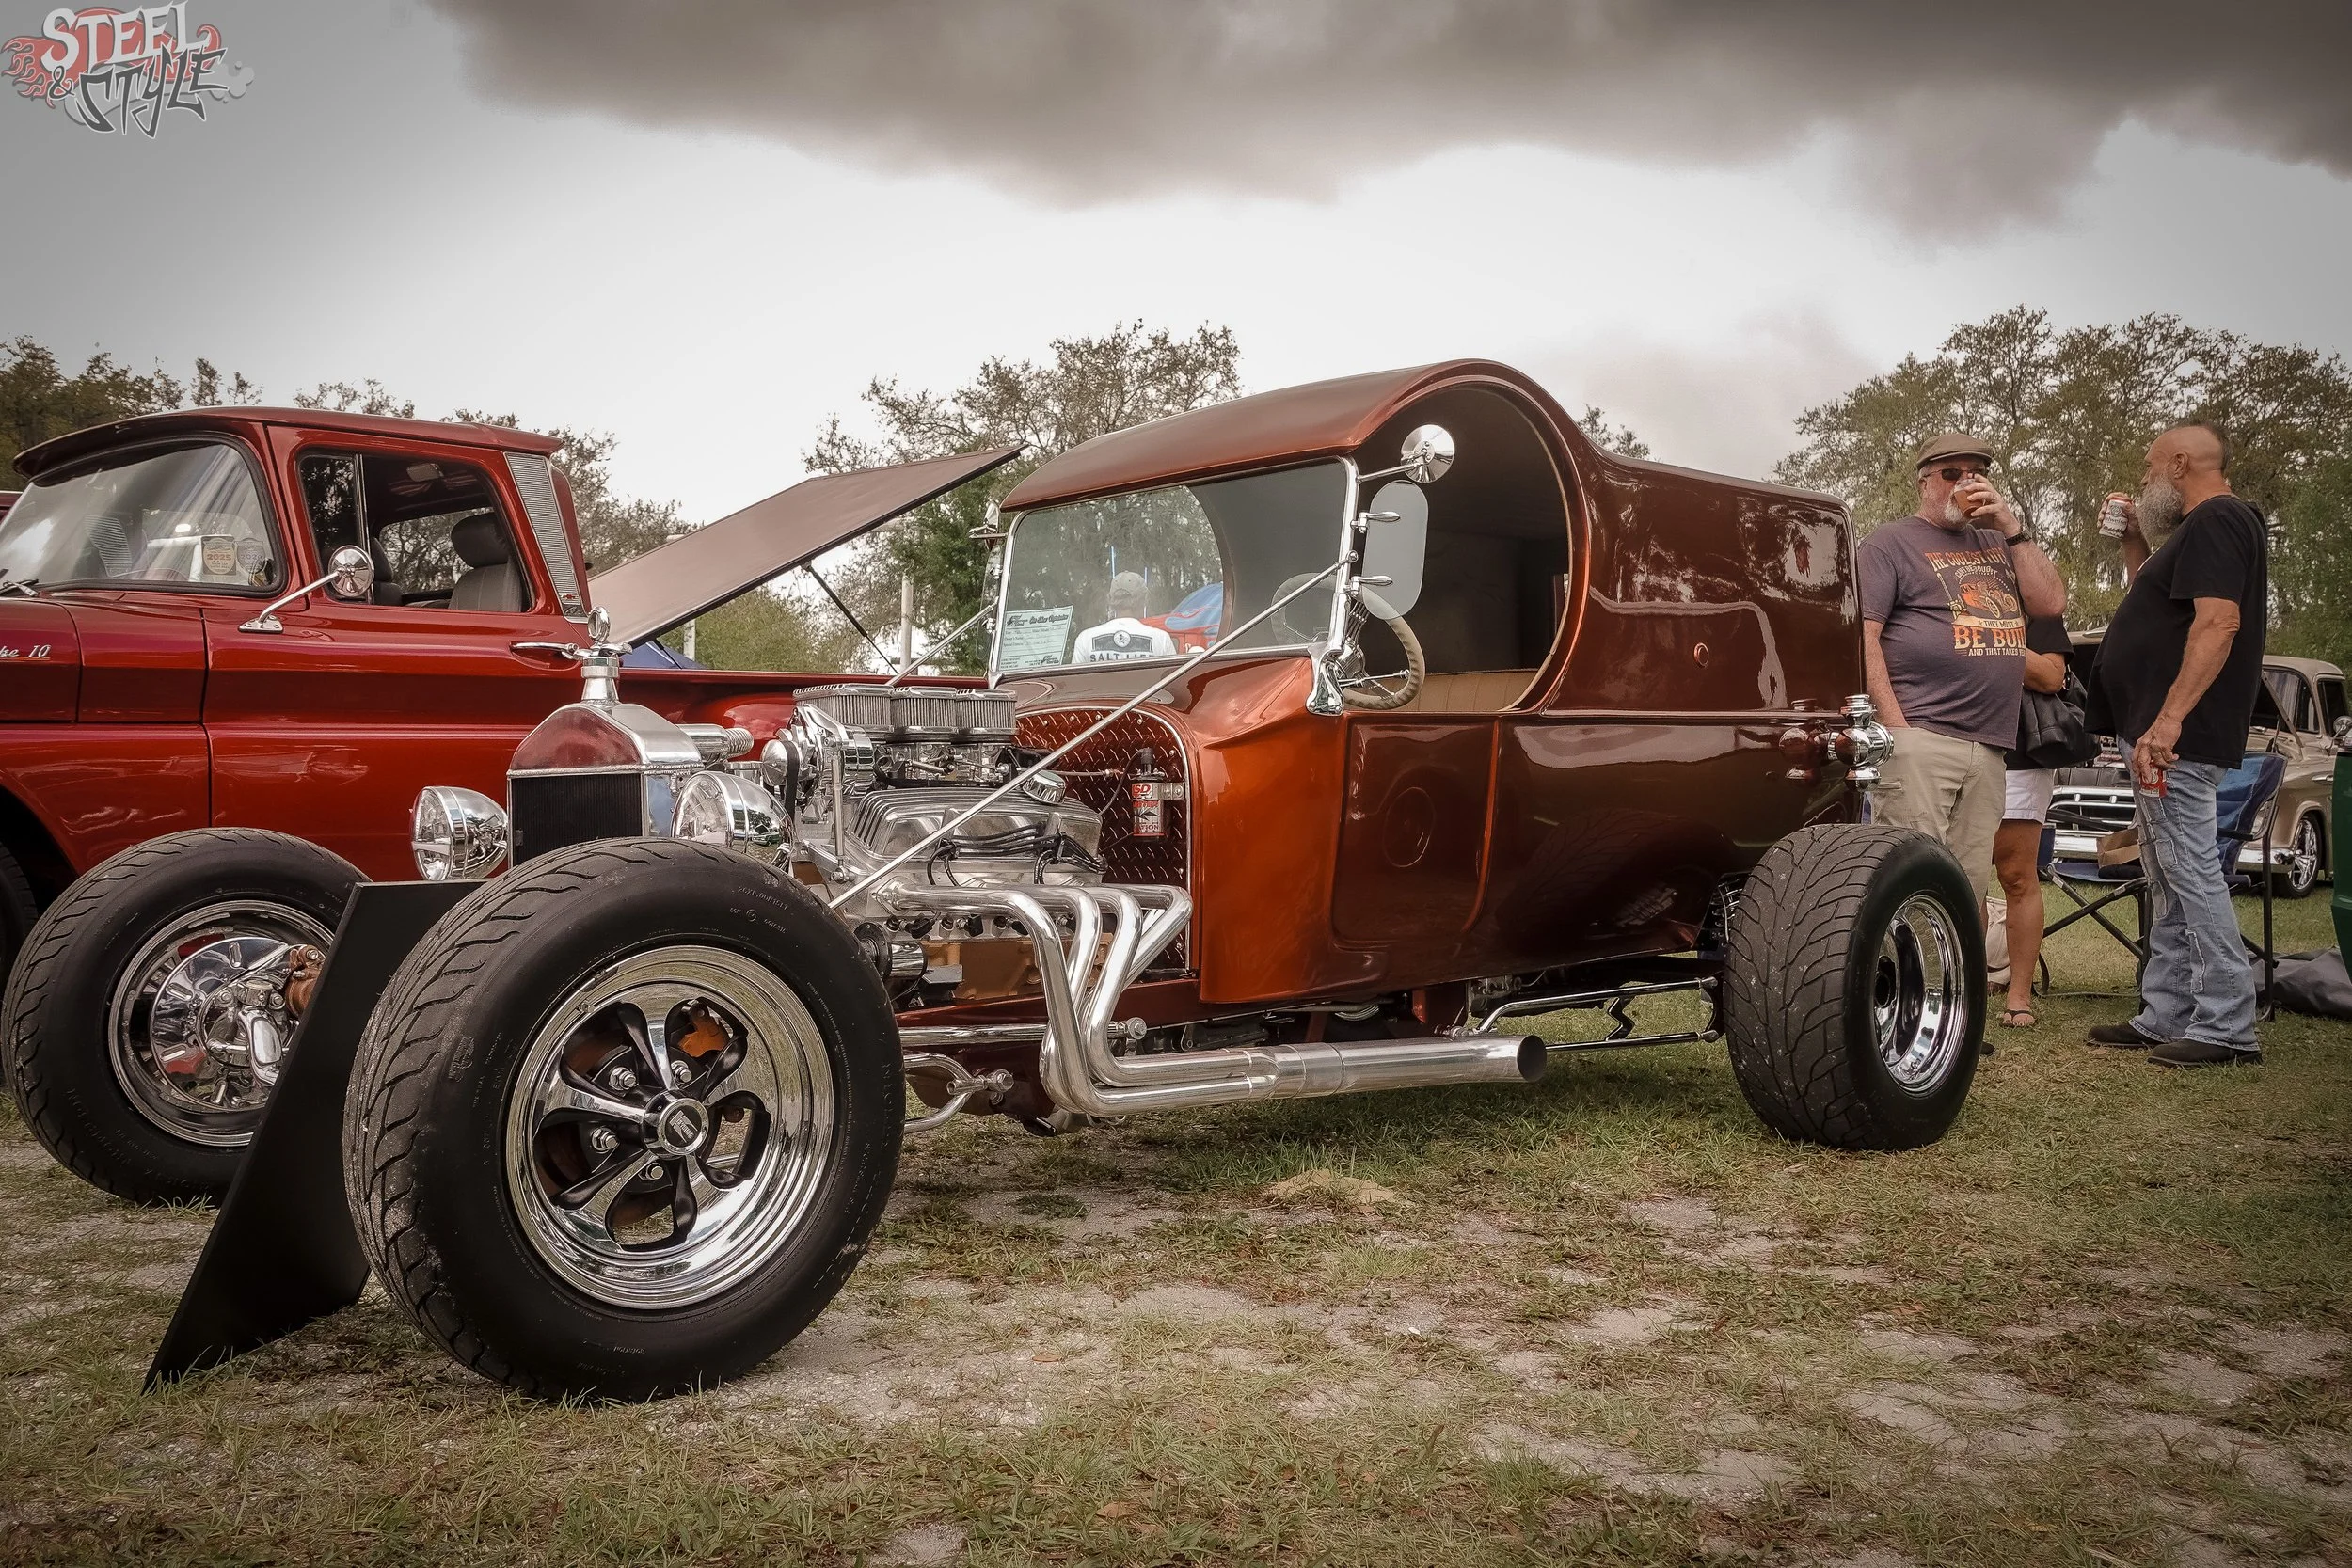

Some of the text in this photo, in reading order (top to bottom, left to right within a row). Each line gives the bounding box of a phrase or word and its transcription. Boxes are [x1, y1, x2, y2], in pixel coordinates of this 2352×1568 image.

[1924, 552, 1949, 572] THE
[1945, 550, 1987, 567] COOLEST
[1953, 625, 2026, 649] BE BUIL
[28, 644, 52, 657] 10
[1968, 648, 1984, 657] AND
[1089, 653, 1120, 662] SALT
